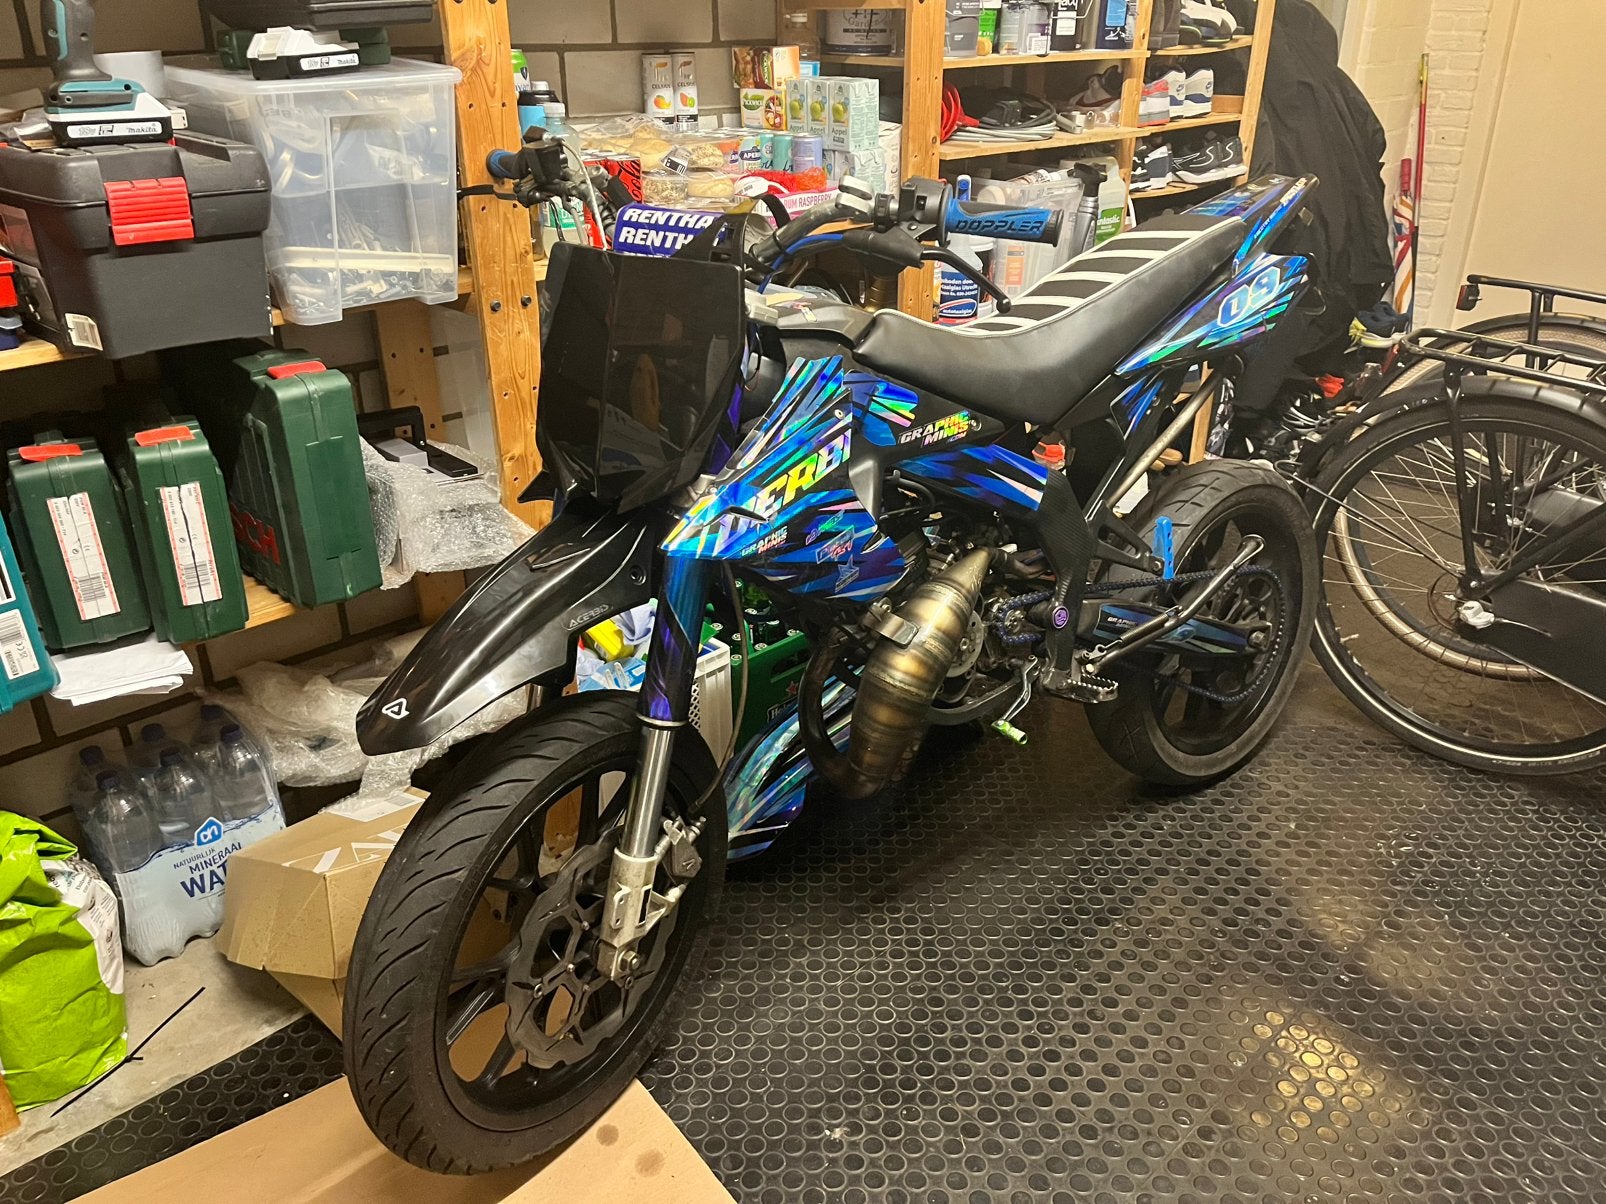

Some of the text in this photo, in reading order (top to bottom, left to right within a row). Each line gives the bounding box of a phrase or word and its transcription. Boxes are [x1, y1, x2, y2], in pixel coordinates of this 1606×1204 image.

[126, 125, 158, 134] makita
[810, 126, 825, 135] Appel
[832, 127, 847, 136] Appel
[955, 218, 1045, 233] DOPPLER
[901, 410, 969, 443] GRAPHIC
[924, 422, 969, 446] MINIS
[173, 847, 217, 870] NATUURLIJK
